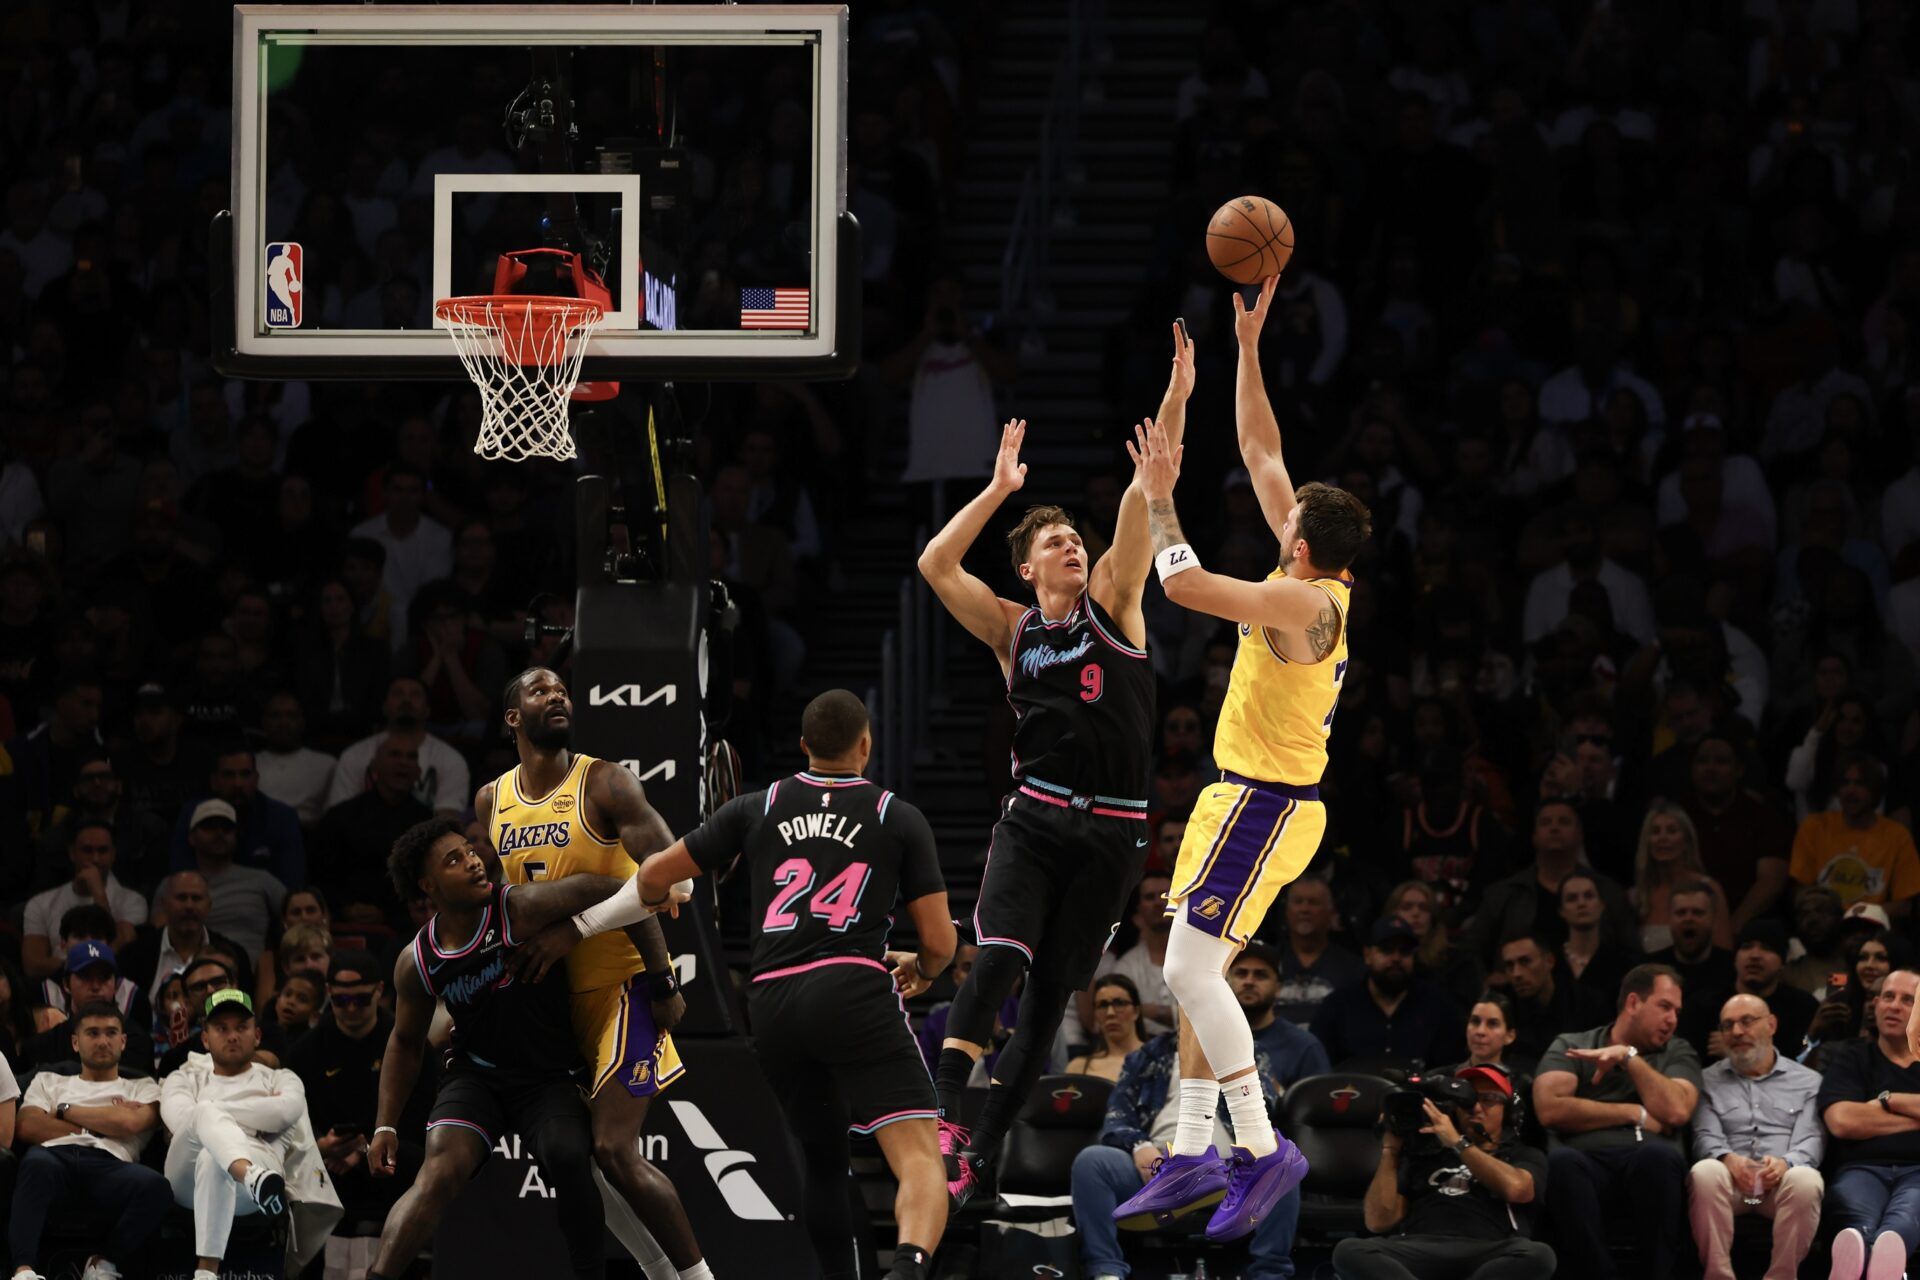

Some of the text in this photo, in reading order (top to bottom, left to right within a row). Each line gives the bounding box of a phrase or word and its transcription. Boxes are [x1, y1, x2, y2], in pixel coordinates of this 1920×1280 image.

[270, 308, 288, 322] NBA
[1019, 632, 1096, 680] Miami
[1080, 663, 1104, 703] 9
[499, 821, 570, 857] LAKERS
[777, 813, 863, 849] POWELL
[762, 858, 872, 933] 24
